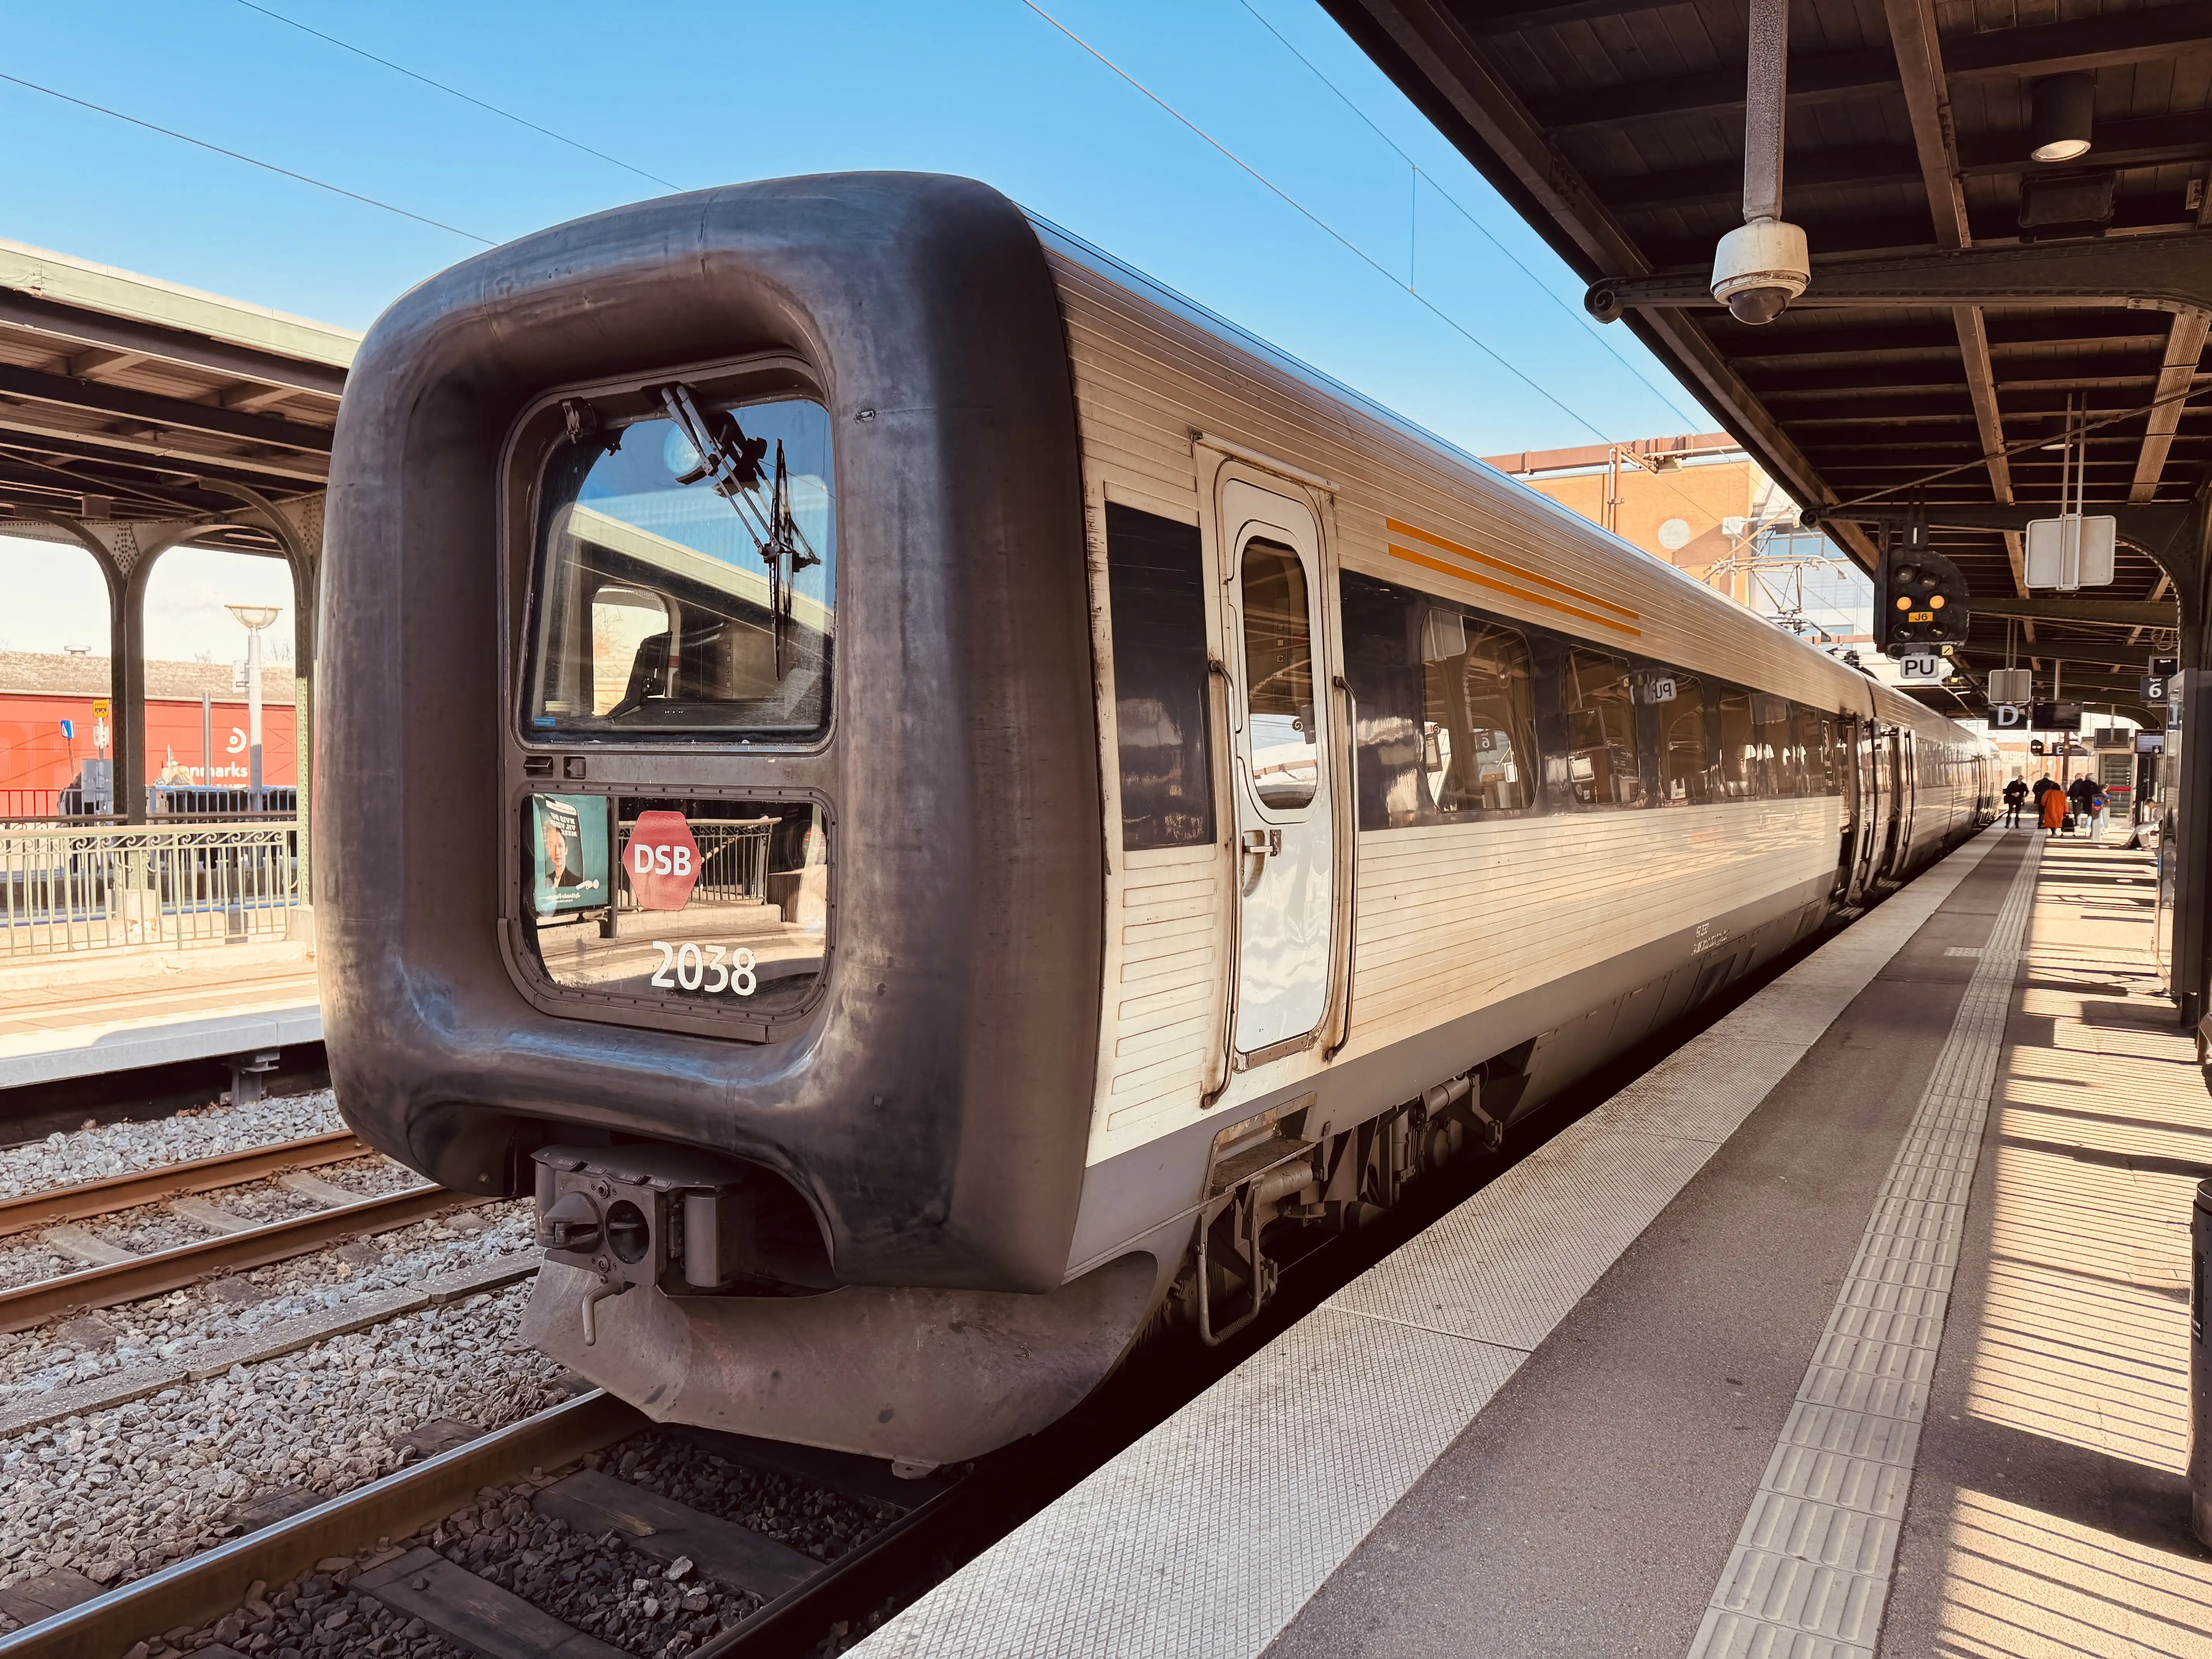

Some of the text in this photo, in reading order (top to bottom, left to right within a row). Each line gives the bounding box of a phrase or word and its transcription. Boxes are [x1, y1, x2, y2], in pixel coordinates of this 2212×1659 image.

[1905, 659, 1934, 675] PU
[2149, 683, 2162, 697] 6
[1998, 706, 2019, 726] D
[2057, 746, 2063, 754] E
[634, 844, 692, 876] DSB
[651, 941, 757, 996] 2038
